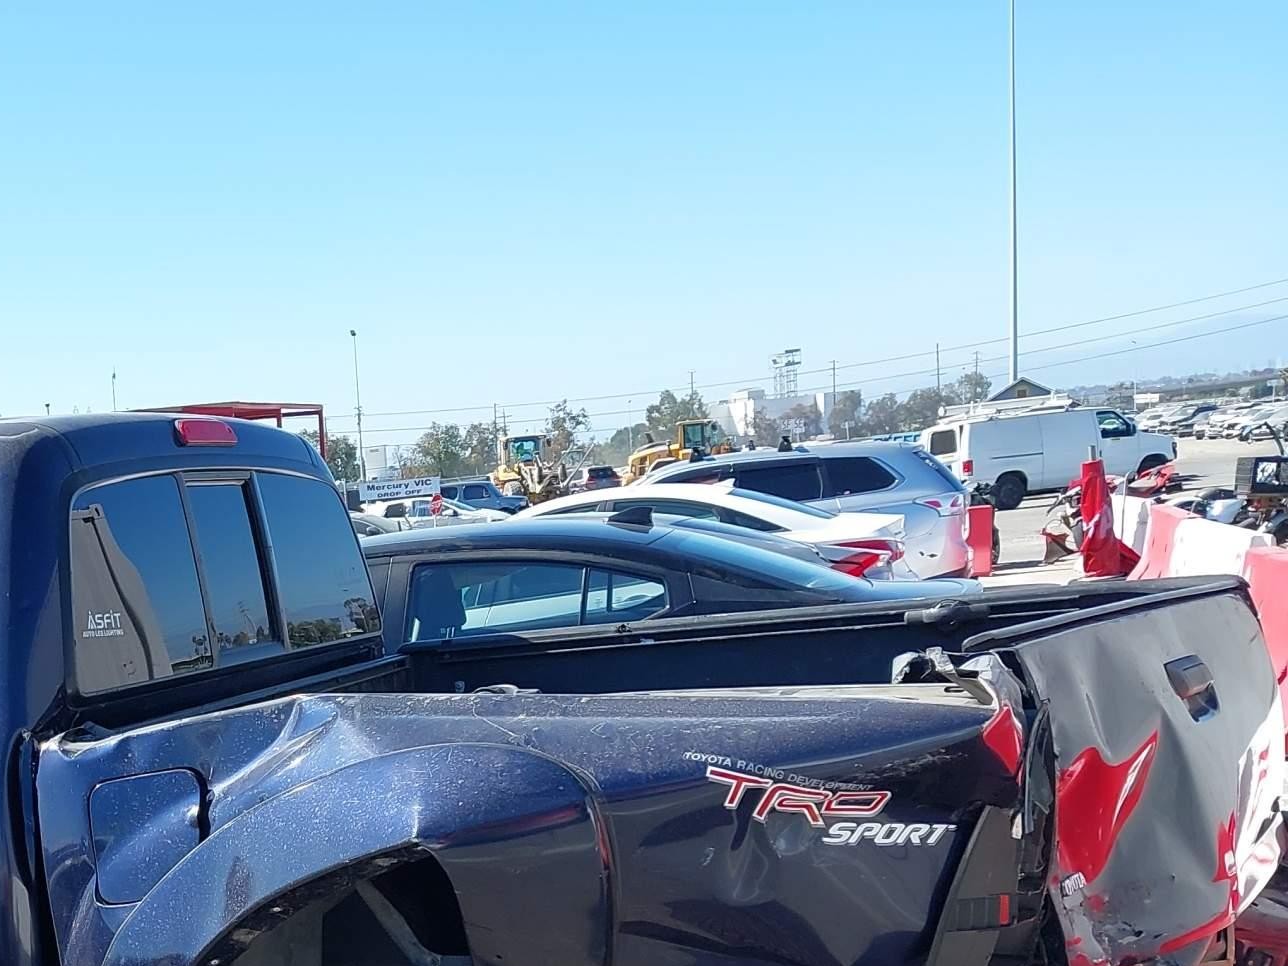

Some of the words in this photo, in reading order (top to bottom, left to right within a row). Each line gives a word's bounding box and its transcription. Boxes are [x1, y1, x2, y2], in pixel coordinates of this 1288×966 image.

[366, 482, 409, 491] Mercury
[414, 478, 432, 487] VIC
[87, 609, 121, 630] ASFIT
[682, 750, 732, 768] TOYOTA
[736, 759, 785, 780] RACING
[787, 773, 874, 792] DEVELOPMENT
[705, 765, 892, 828] TRD
[822, 822, 952, 846] SPORT
